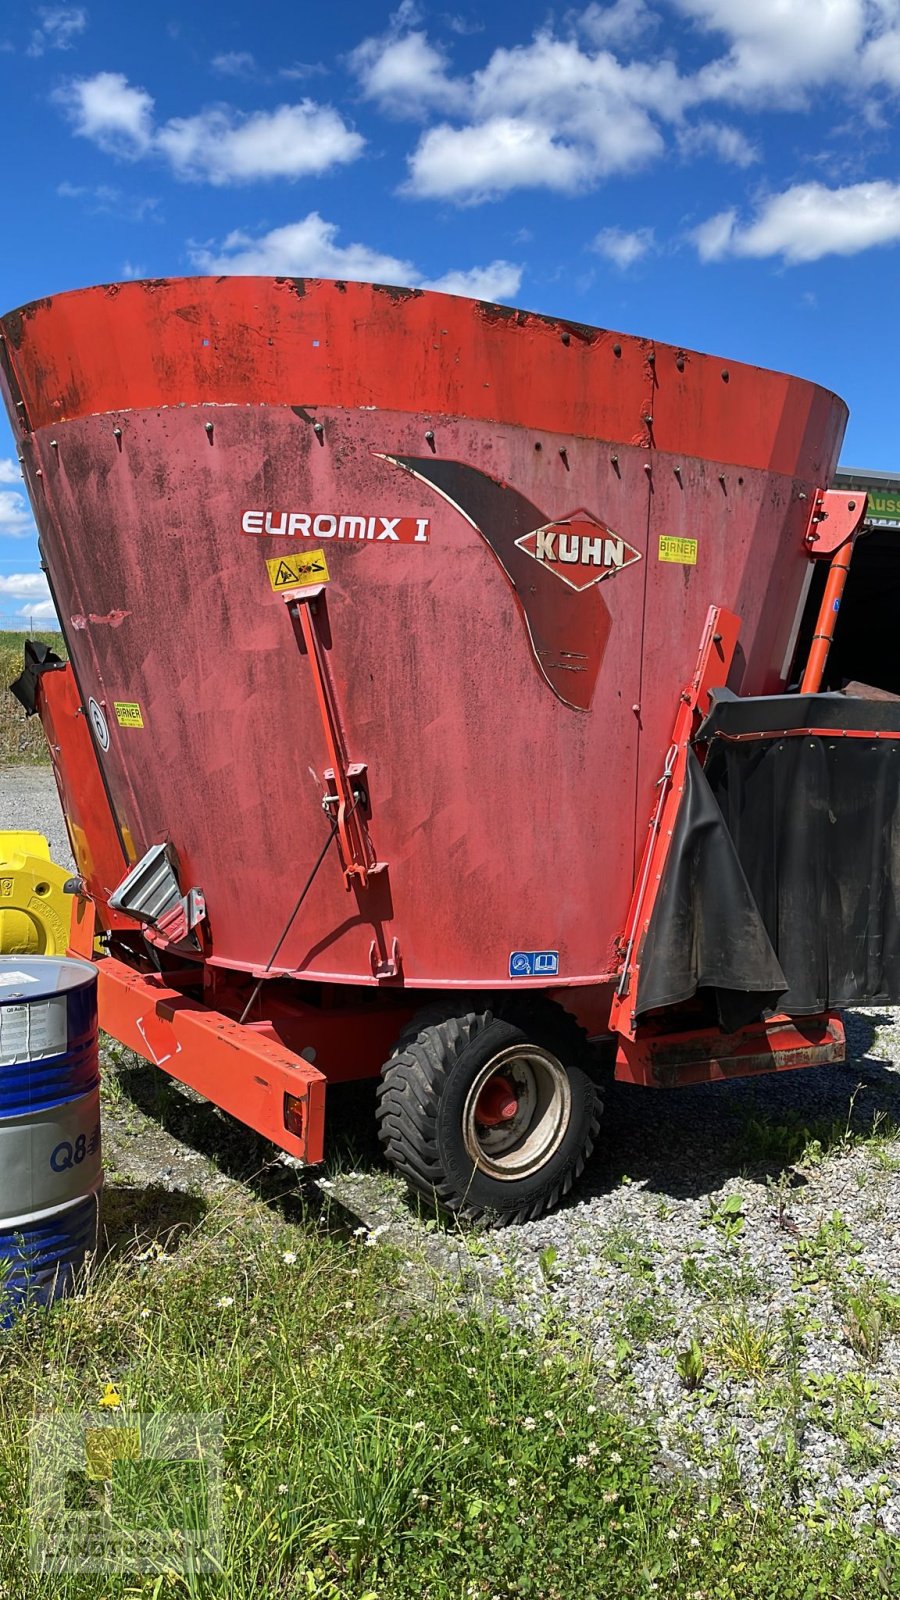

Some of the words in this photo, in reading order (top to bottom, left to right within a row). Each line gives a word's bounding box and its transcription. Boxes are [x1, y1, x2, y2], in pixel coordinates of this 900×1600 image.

[242, 511, 401, 541] EUROMIX
[414, 519, 429, 542] I
[535, 530, 624, 567] KUHN
[660, 541, 696, 555] BIRNER
[115, 707, 140, 718] BIRNER
[50, 1133, 87, 1173] Q8
